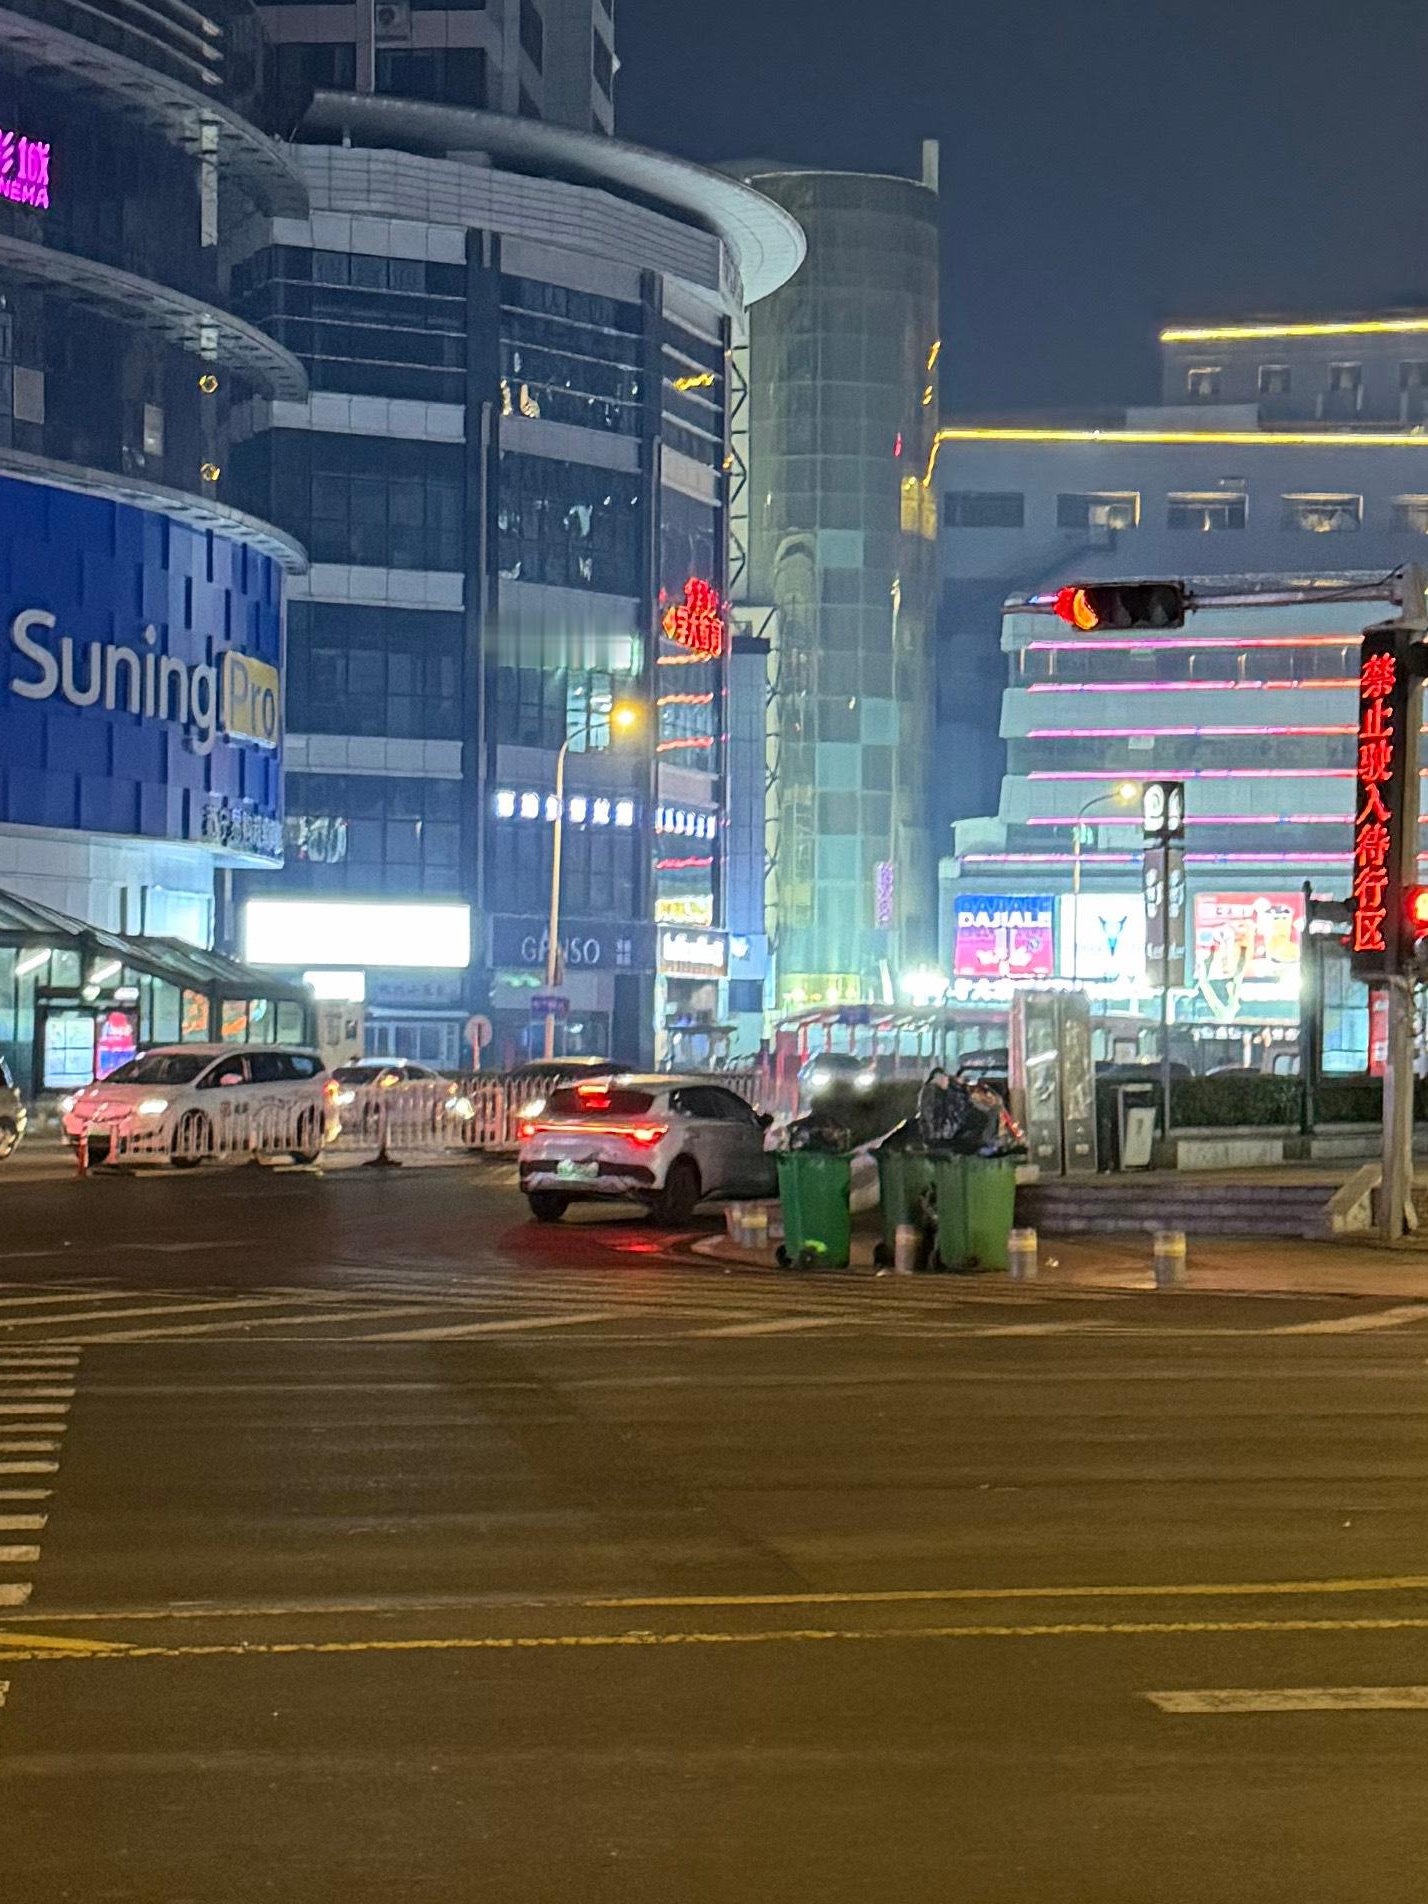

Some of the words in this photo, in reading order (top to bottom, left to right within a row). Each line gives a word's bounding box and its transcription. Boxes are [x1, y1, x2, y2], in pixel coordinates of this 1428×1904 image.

[11, 608, 218, 756] Suning
[230, 658, 278, 738] Pro
[1353, 652, 1396, 952] 禁止驶入待行区
